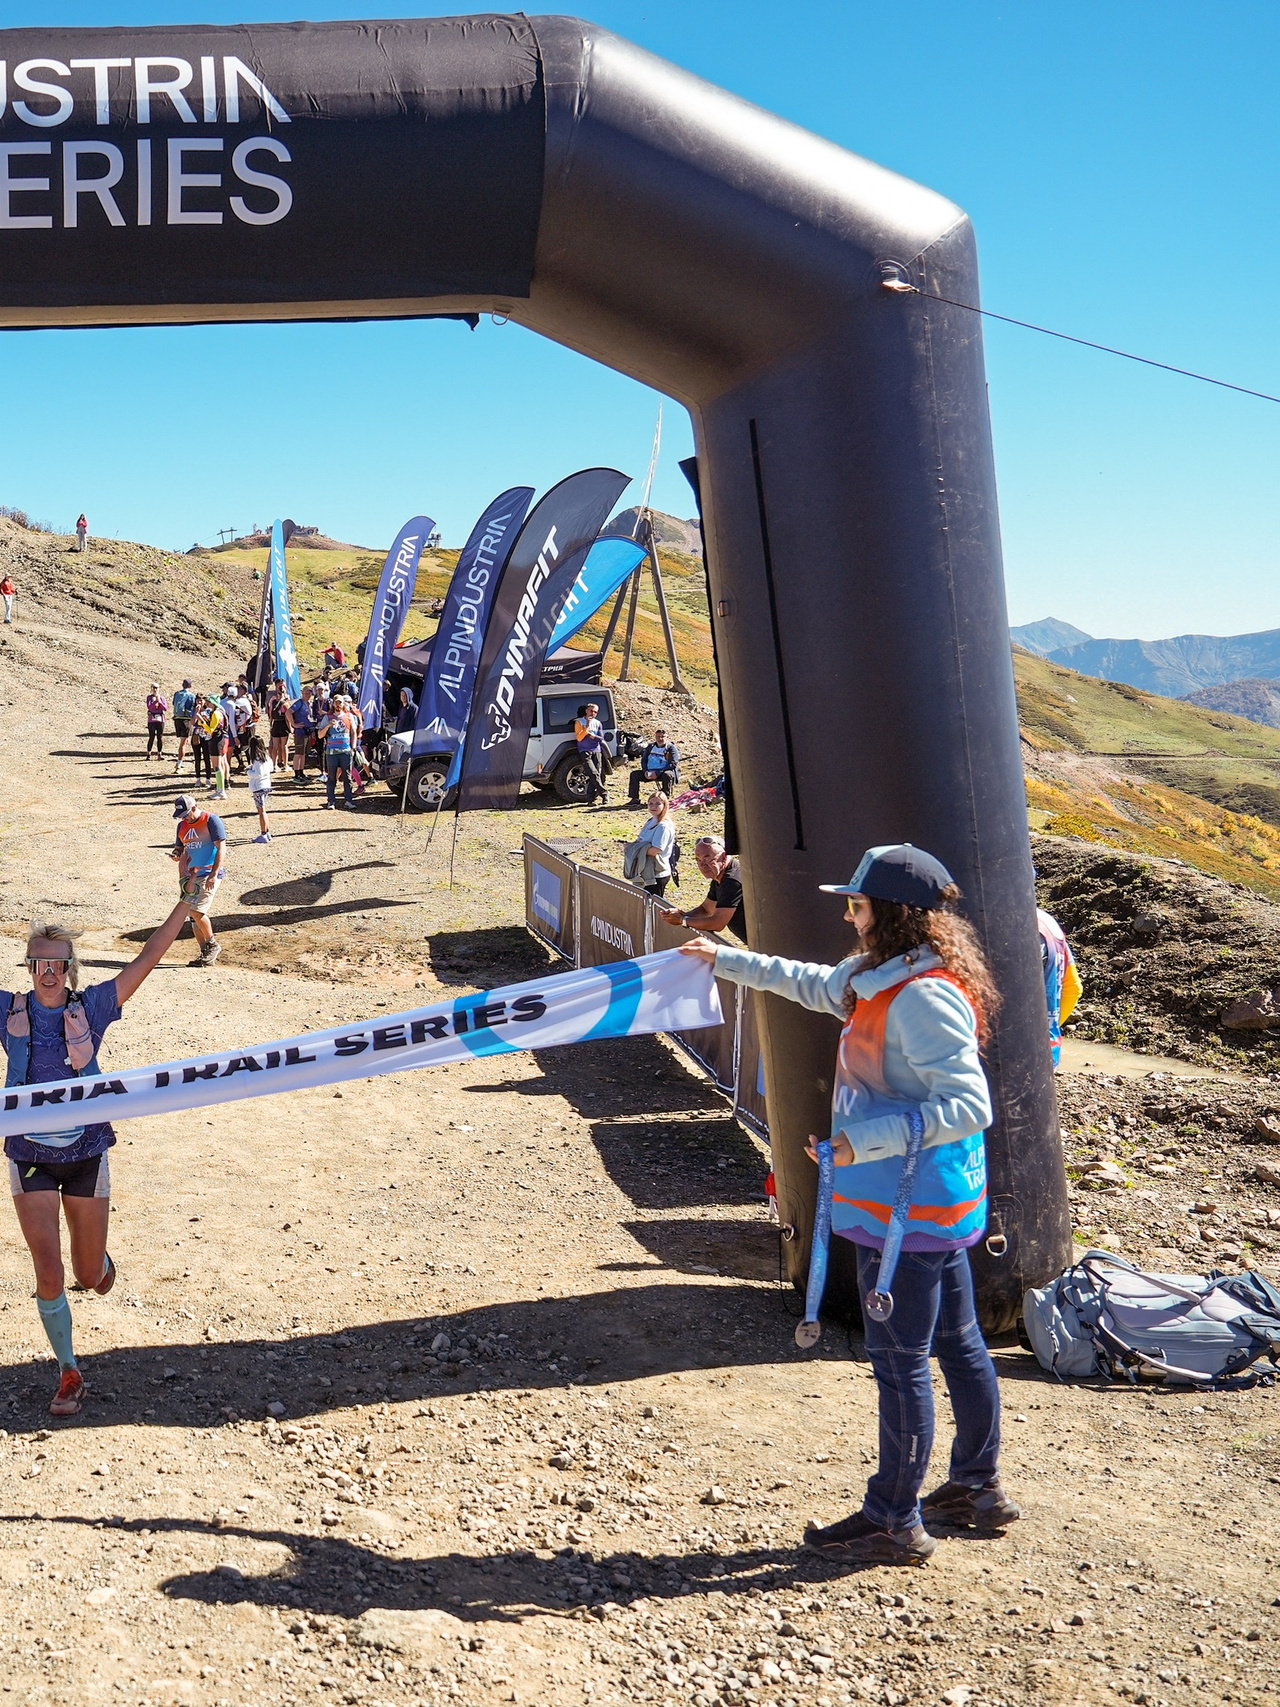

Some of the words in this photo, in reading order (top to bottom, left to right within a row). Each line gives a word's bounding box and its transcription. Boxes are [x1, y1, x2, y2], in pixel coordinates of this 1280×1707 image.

[438, 513, 512, 703] ALPINDUSTRIA
[495, 525, 560, 716] DYNAFIT
[590, 915, 635, 957] ALPINDUSTRIA
[334, 994, 547, 1056] SERIES
